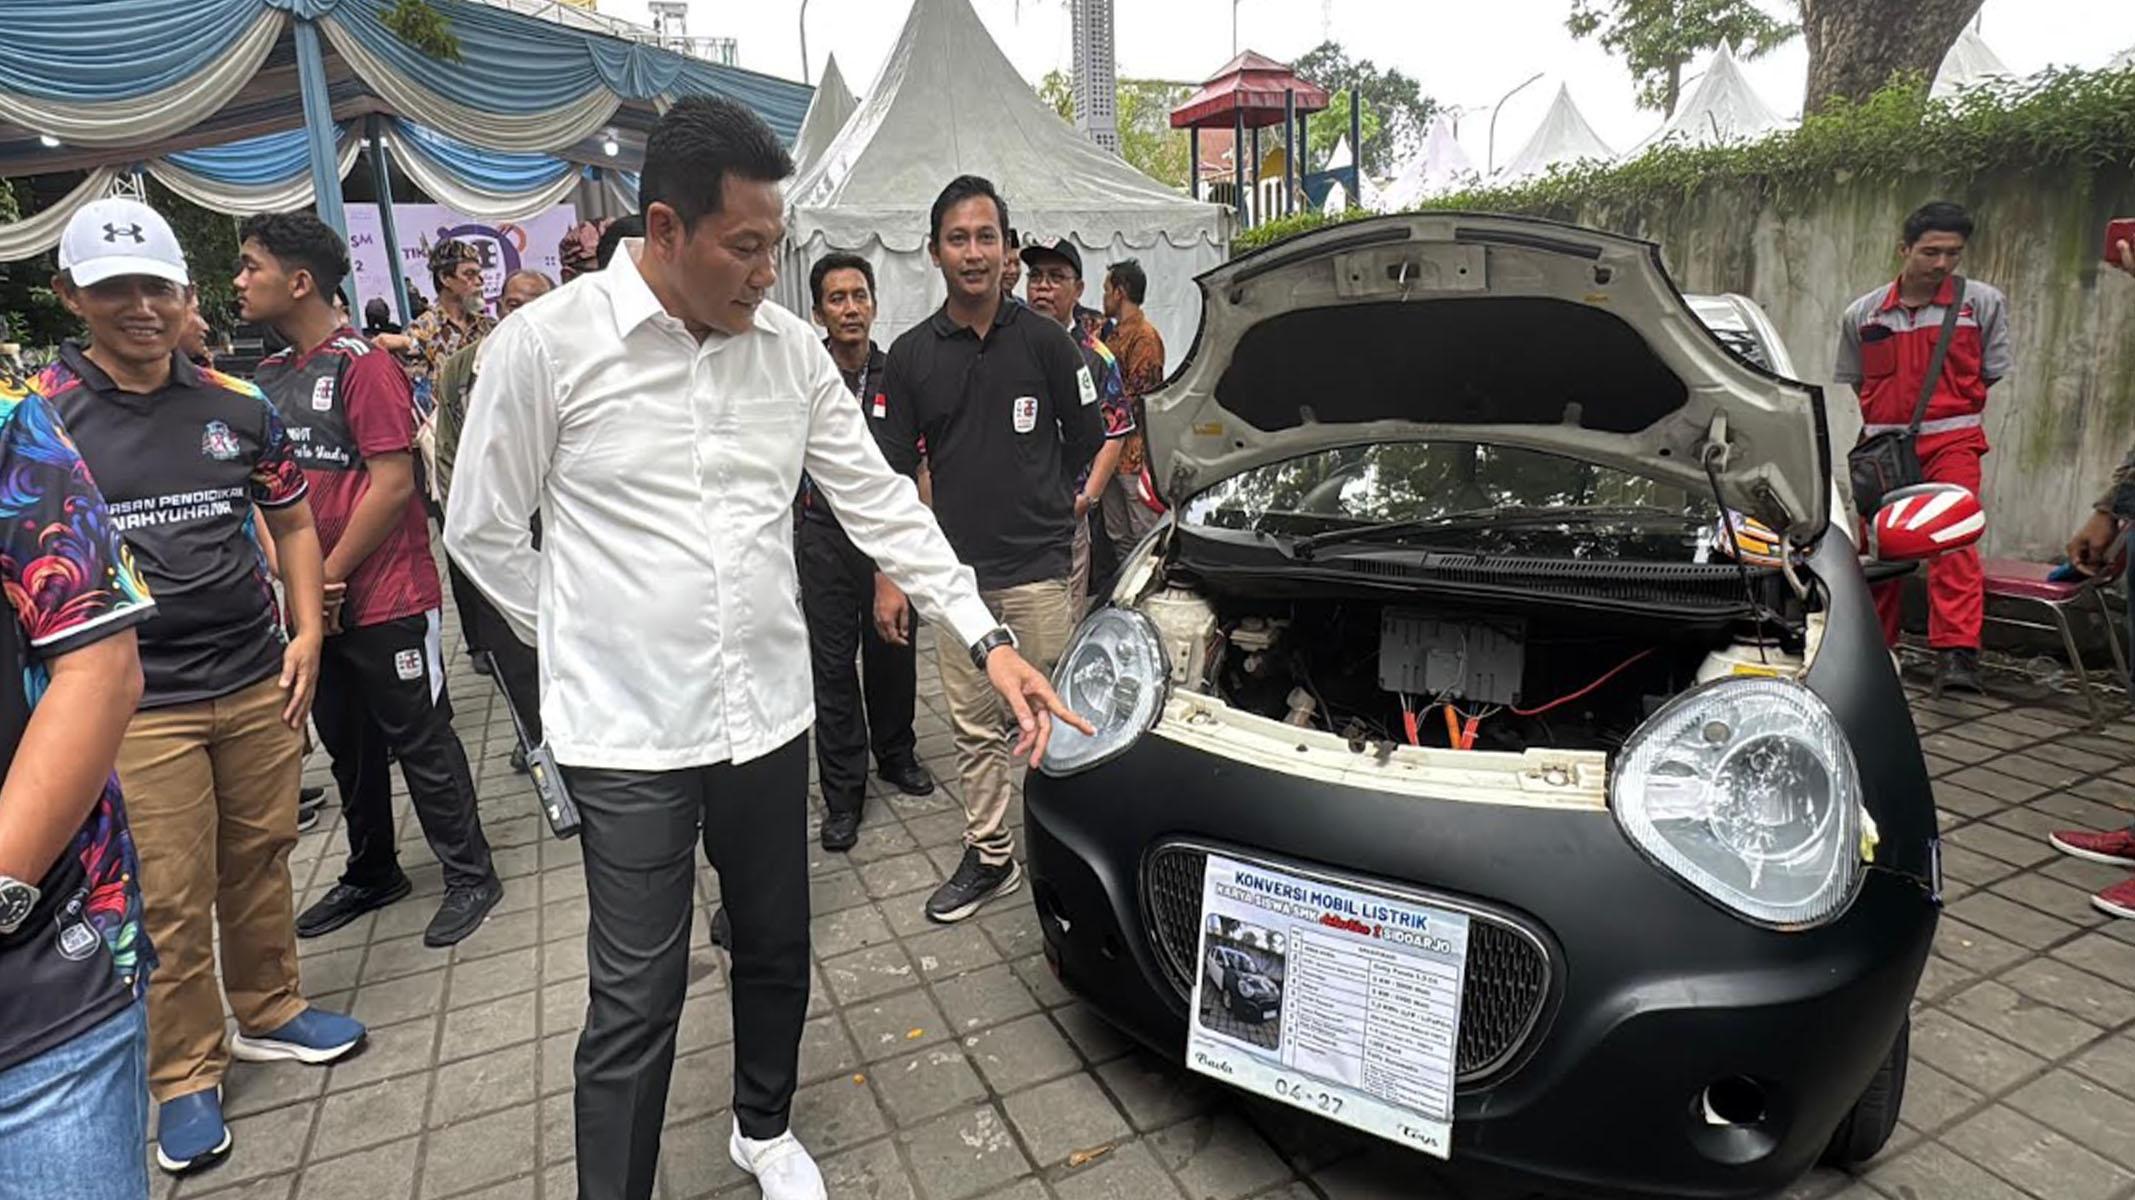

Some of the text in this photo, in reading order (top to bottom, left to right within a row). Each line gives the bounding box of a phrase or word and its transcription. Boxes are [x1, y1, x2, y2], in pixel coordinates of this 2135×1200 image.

[109, 487, 244, 514] ASAN PENDIDIKAN
[1215, 882, 1253, 905] KARYA
[1254, 894, 1292, 917] SISWA
[1292, 903, 1319, 924] SMK
[1235, 871, 1428, 930] KONVERSI MOBIL LISTRIK
